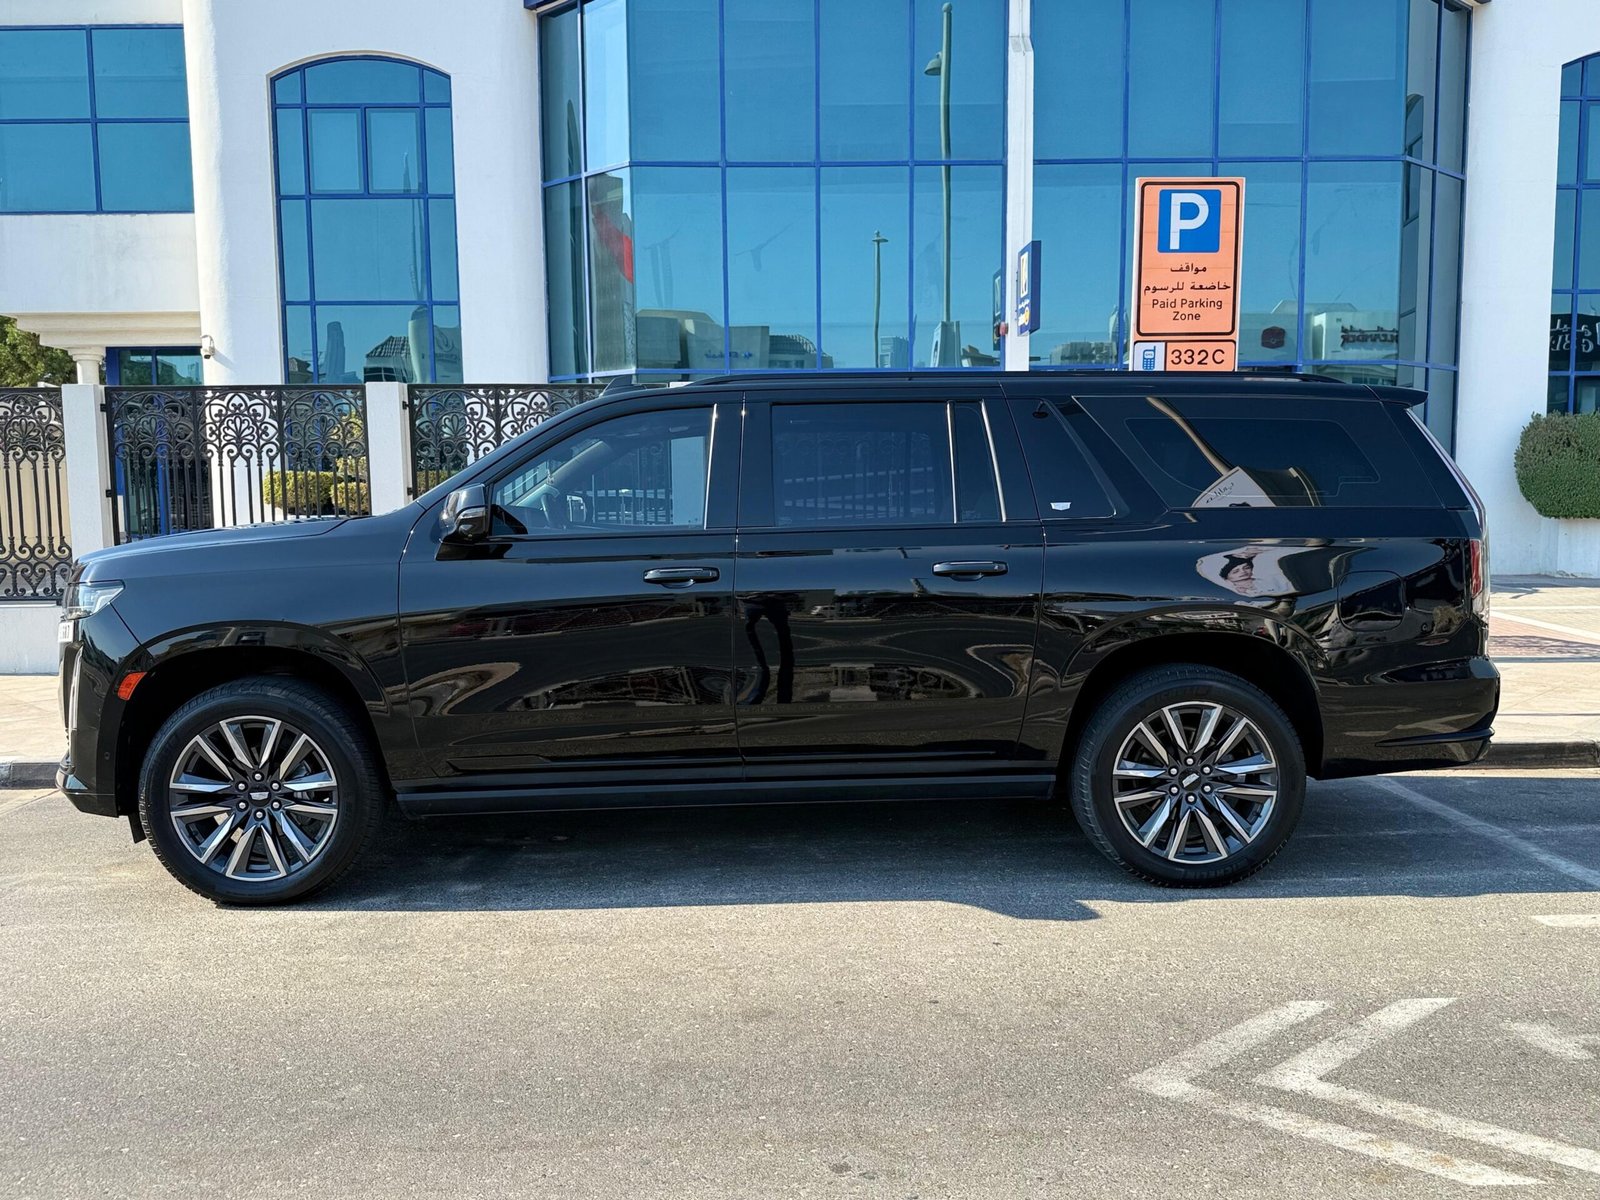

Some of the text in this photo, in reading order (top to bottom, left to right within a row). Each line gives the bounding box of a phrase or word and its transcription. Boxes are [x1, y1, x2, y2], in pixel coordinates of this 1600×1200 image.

[1169, 193, 1209, 249] P
[1170, 262, 1207, 275] مواقف
[1144, 281, 1231, 296] خاضعة للرسوم
[1152, 298, 1223, 310] Paid Parking
[1172, 311, 1201, 321] Zone
[1170, 349, 1225, 366] 332C
